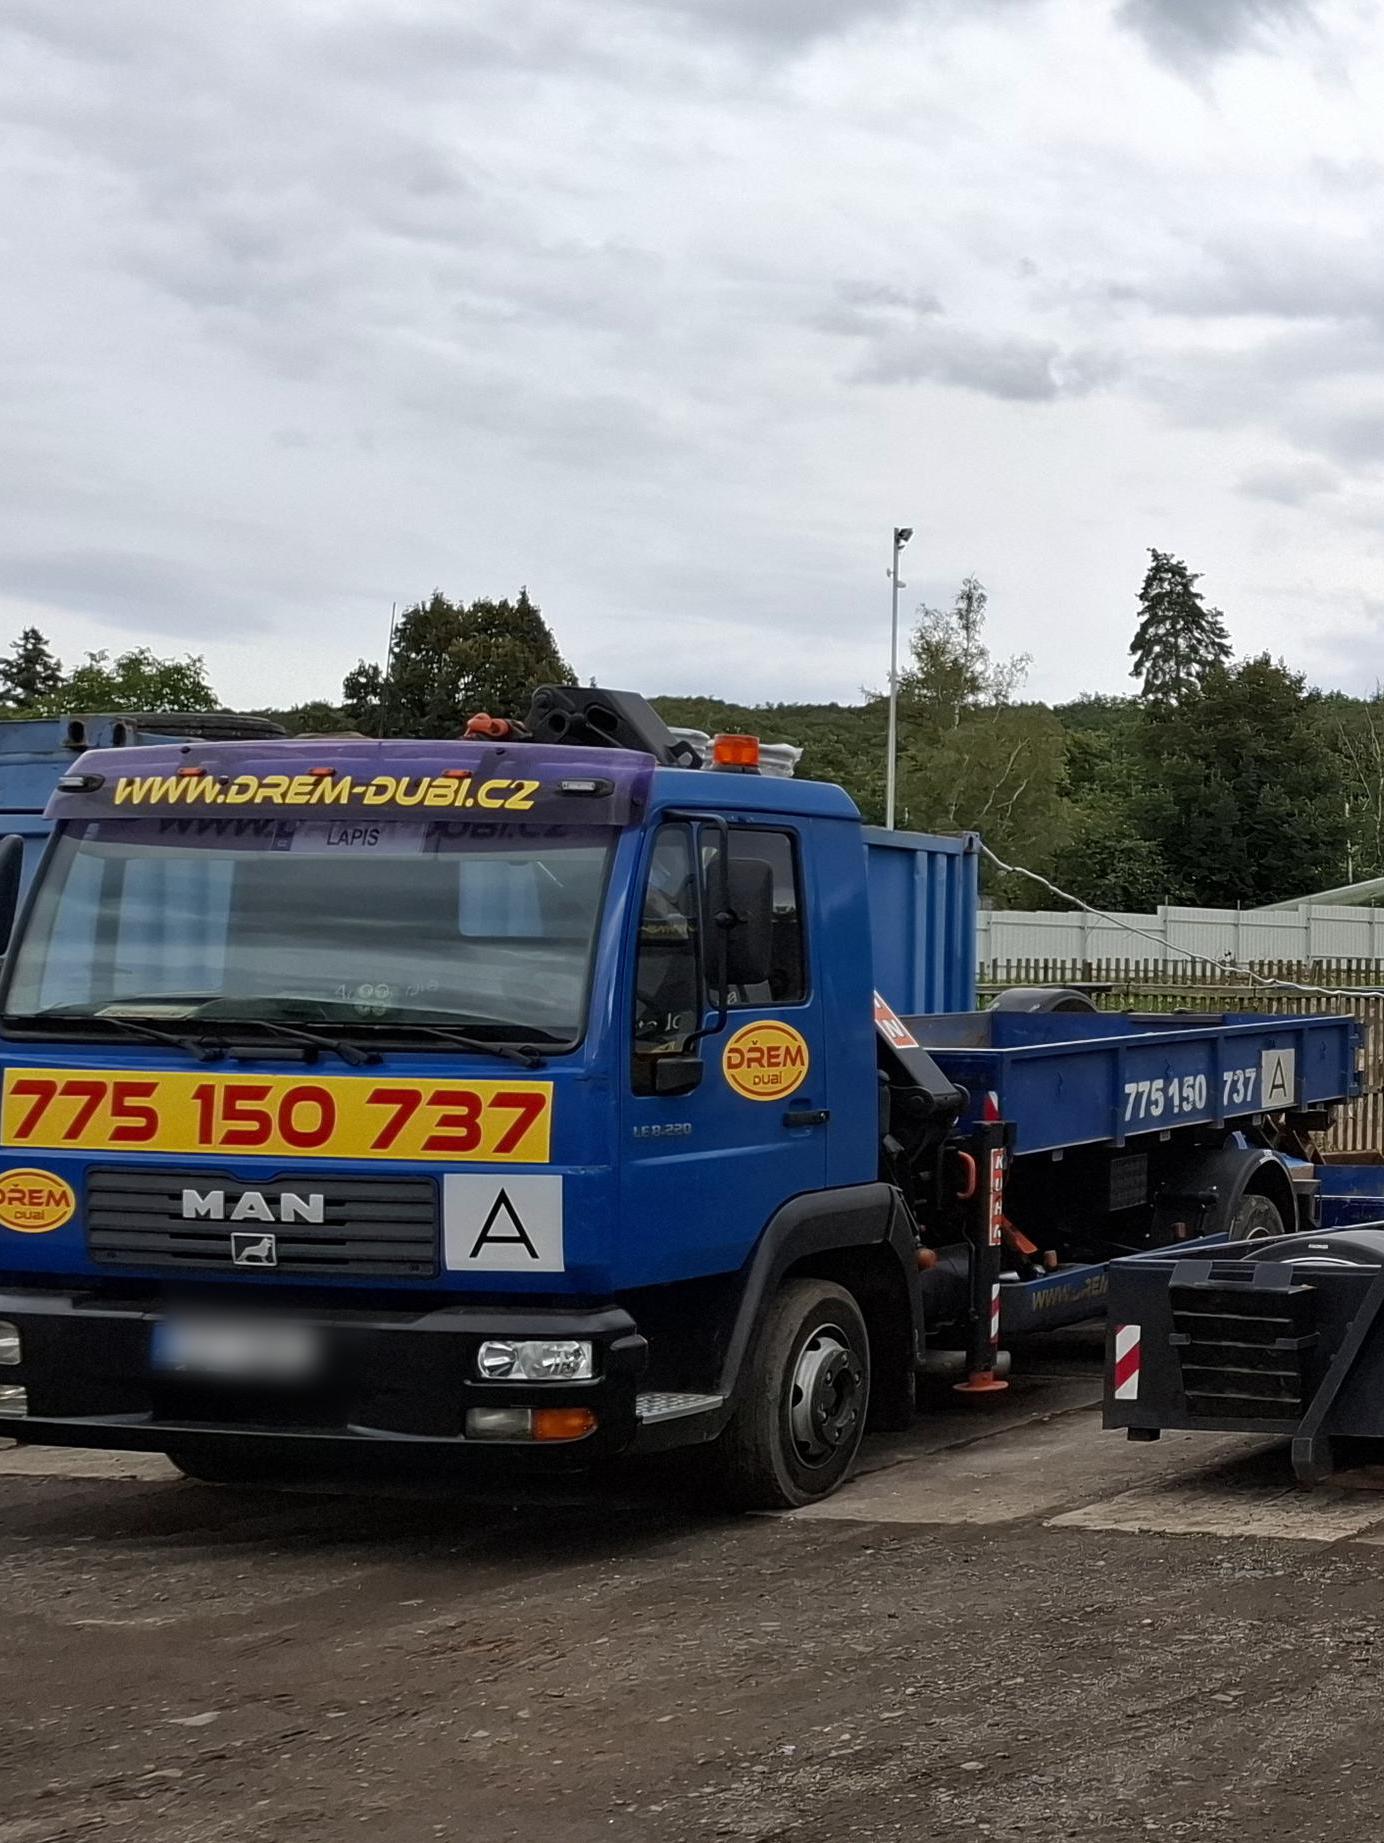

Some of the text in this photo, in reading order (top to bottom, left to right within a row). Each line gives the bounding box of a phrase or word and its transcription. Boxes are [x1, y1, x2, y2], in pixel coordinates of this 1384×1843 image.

[114, 775, 540, 809] WWW.DREM-DUBI.CZ
[326, 828, 381, 847] LAPIS
[726, 1039, 806, 1070] DŘEM
[1124, 1067, 1257, 1121] 775 150 737
[1268, 1055, 1288, 1099] A
[9, 1079, 547, 1154] 775 150 737
[182, 1189, 324, 1224] MAN
[469, 1187, 540, 1260] A
